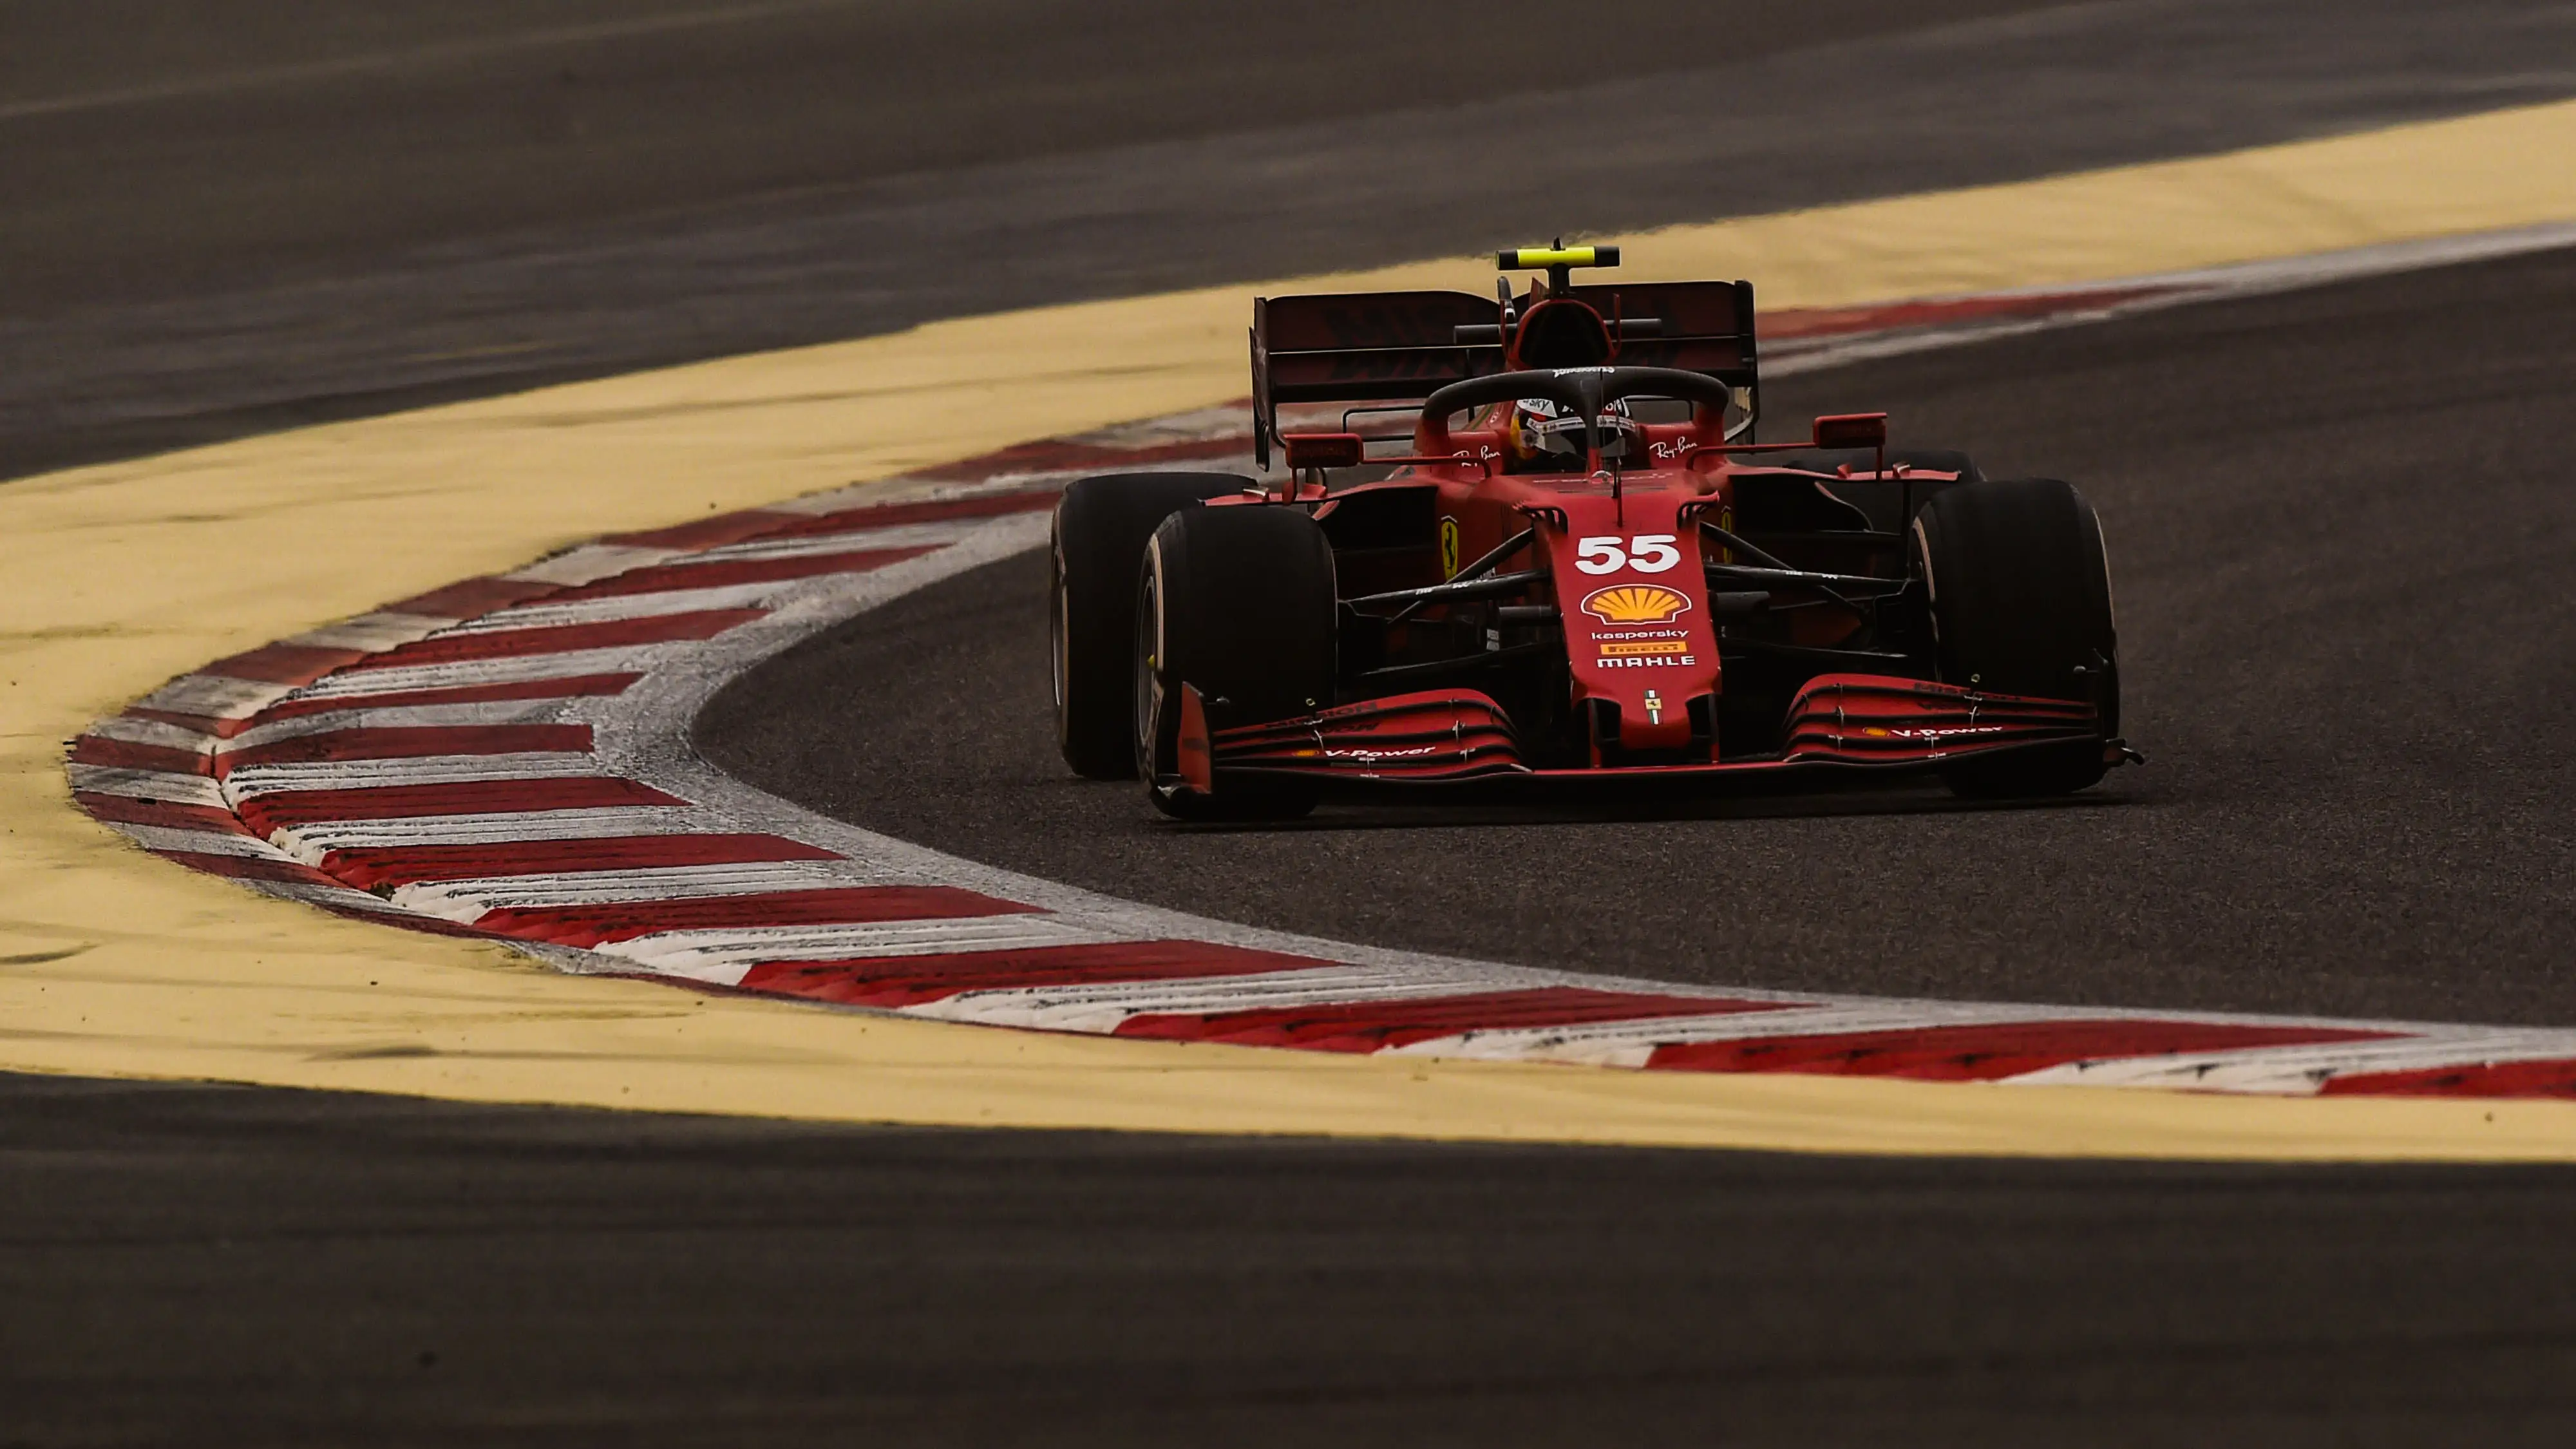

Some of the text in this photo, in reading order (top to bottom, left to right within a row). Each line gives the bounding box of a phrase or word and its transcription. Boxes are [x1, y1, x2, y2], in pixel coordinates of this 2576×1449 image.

[1649, 436, 1698, 459] Ray-Ban
[1575, 534, 1681, 575] 55
[1597, 656, 1696, 668] MAHLE
[1891, 725, 2003, 738] V-Power
[1325, 746, 1436, 759] V-Power
